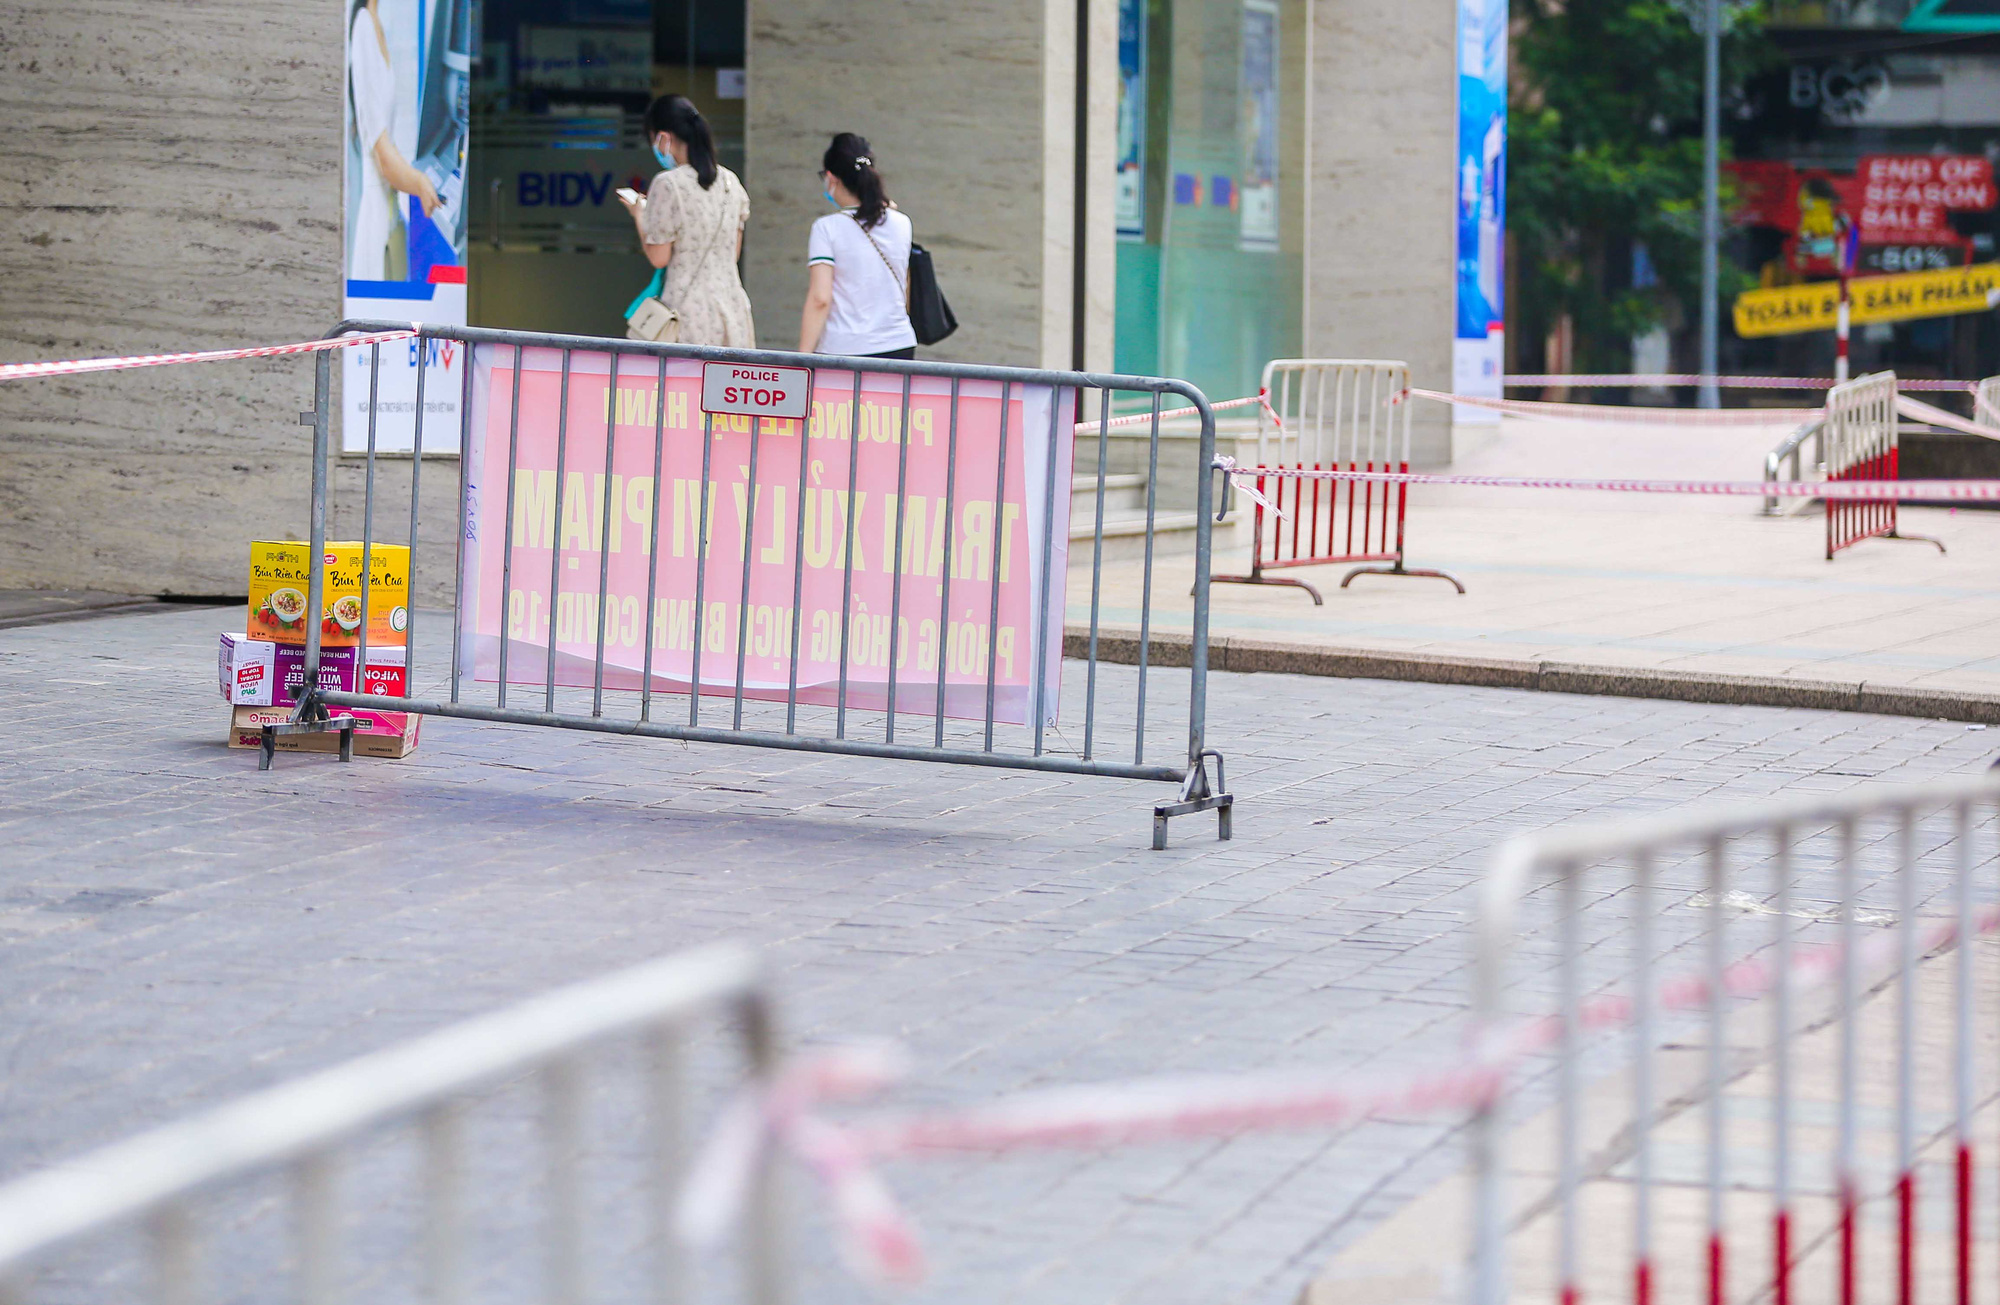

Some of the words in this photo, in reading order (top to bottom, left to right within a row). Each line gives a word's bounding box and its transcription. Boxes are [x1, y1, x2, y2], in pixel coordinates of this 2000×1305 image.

[1868, 159, 1932, 181] END
[1940, 159, 1984, 181] OF
[517, 172, 613, 207] BIDV
[1866, 182, 1987, 207] SEASON
[1861, 207, 1935, 229] SALE
[732, 369, 779, 382] POLICE
[723, 386, 787, 407] STOP
[253, 565, 272, 577] Bún
[330, 571, 355, 587] Bún
[384, 573, 403, 587] Cua
[335, 651, 351, 659] WITH
[321, 665, 338, 673] PHỞ
[363, 669, 400, 682] VIFON
[240, 673, 261, 683] GLOBAL
[284, 671, 305, 682] EEF
[240, 681, 259, 690] VIFON
[249, 711, 291, 724] Omac
